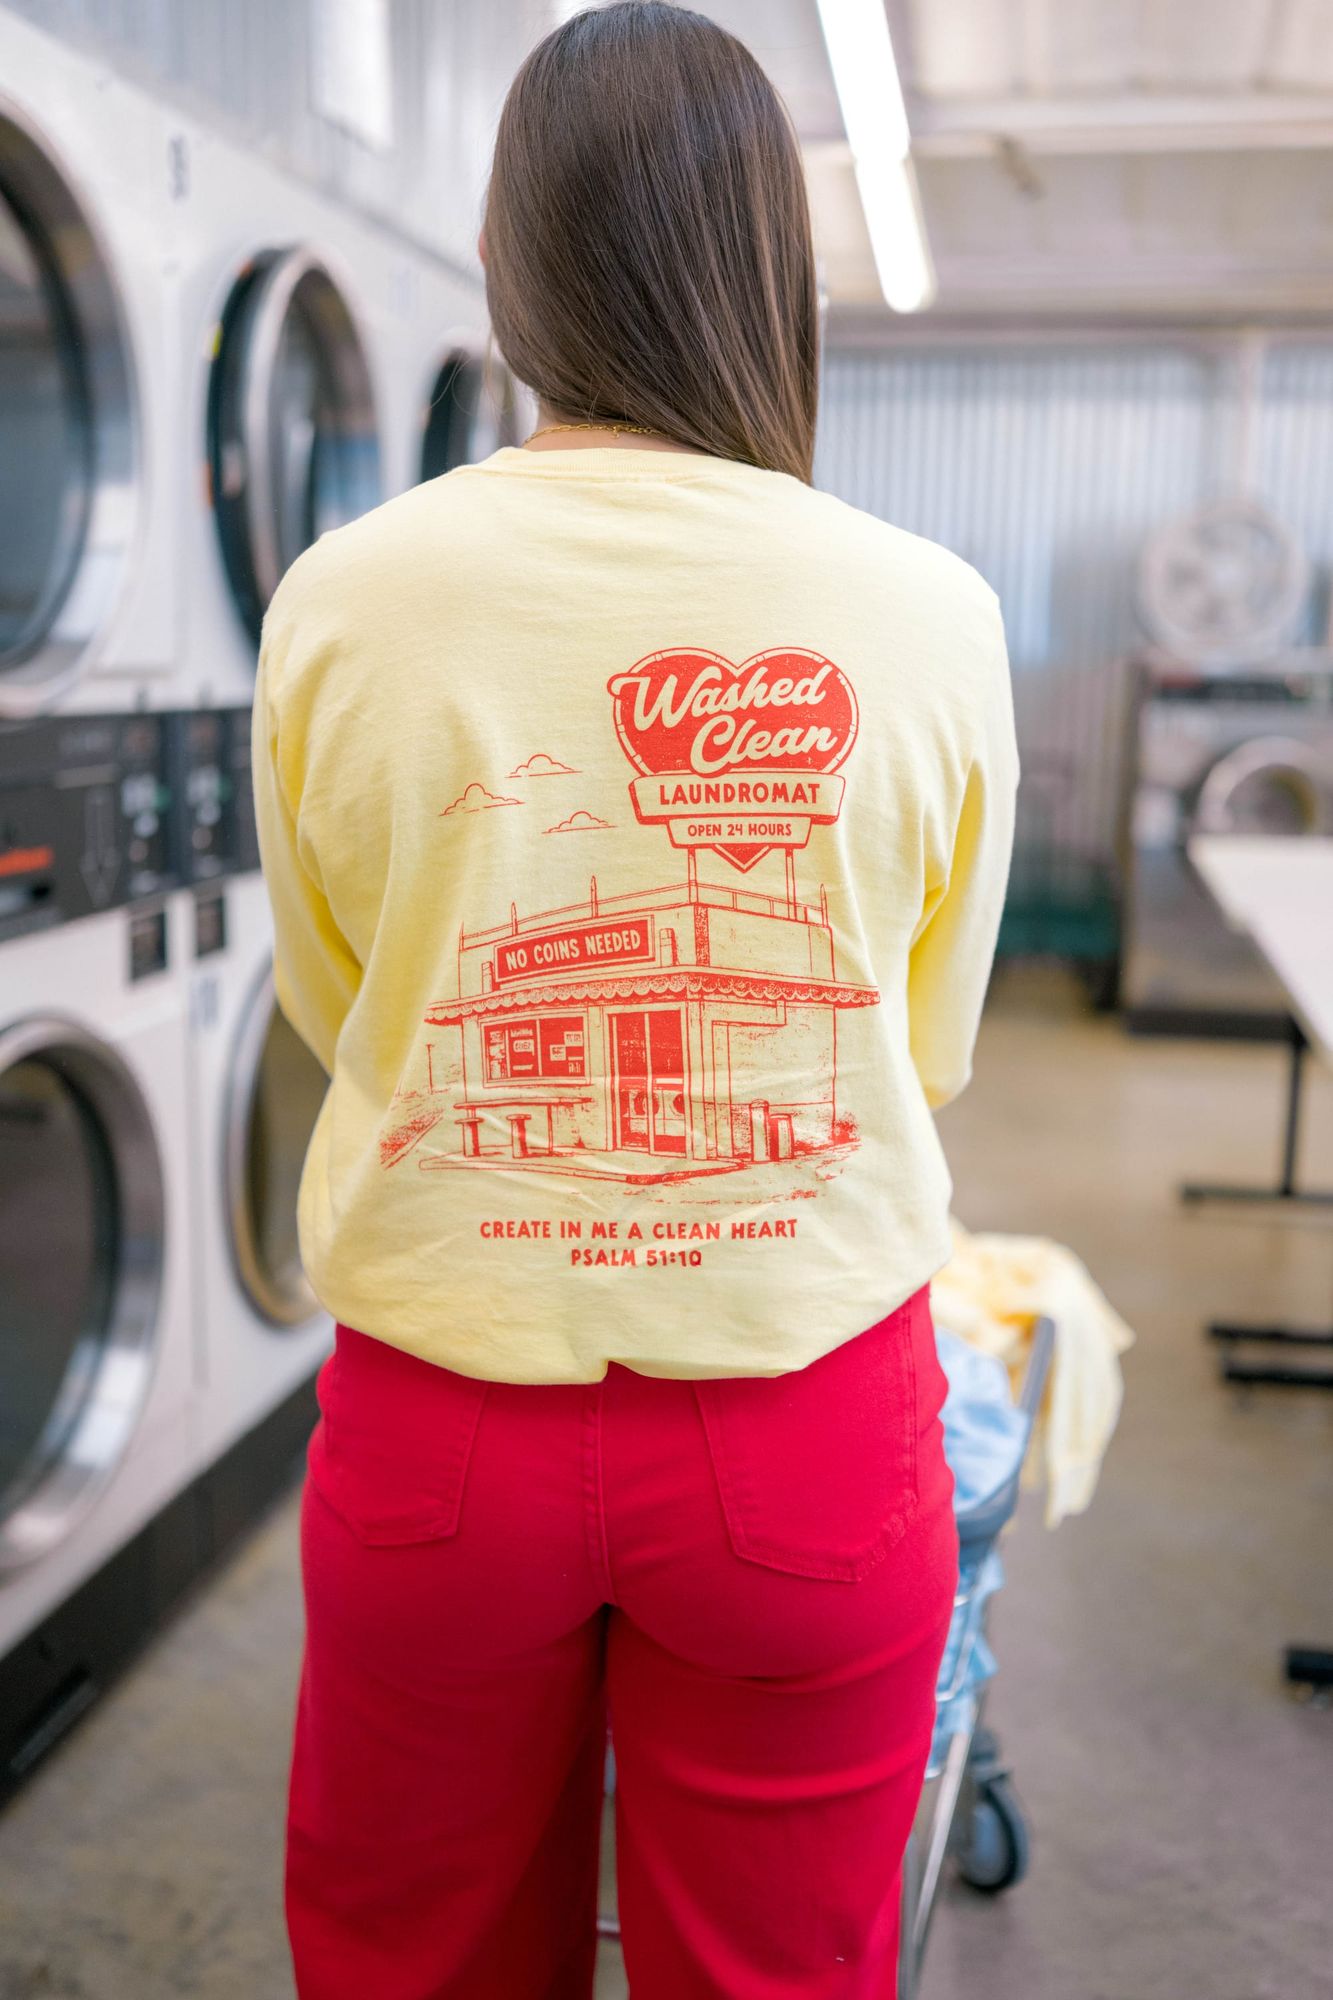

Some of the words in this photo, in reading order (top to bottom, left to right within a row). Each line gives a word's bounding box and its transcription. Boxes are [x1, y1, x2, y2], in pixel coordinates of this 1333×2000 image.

[611, 665, 833, 731] Washed
[690, 714, 838, 774] Clean
[659, 783, 820, 805] LAUNDROMAT
[687, 823, 722, 837] OPEN
[727, 823, 743, 836] 24
[748, 823, 792, 837] HOURS
[505, 949, 528, 971] NO
[533, 938, 580, 964] COINS
[585, 929, 641, 956] NEEDED
[479, 1220, 551, 1239] CREATE
[560, 1220, 582, 1239] IN
[591, 1221, 618, 1239] ME
[627, 1222, 643, 1239] A
[652, 1222, 720, 1240] CLEAN
[731, 1218, 798, 1239] HEART
[571, 1248, 637, 1267] PSALM
[646, 1249, 702, 1267] 51:10
